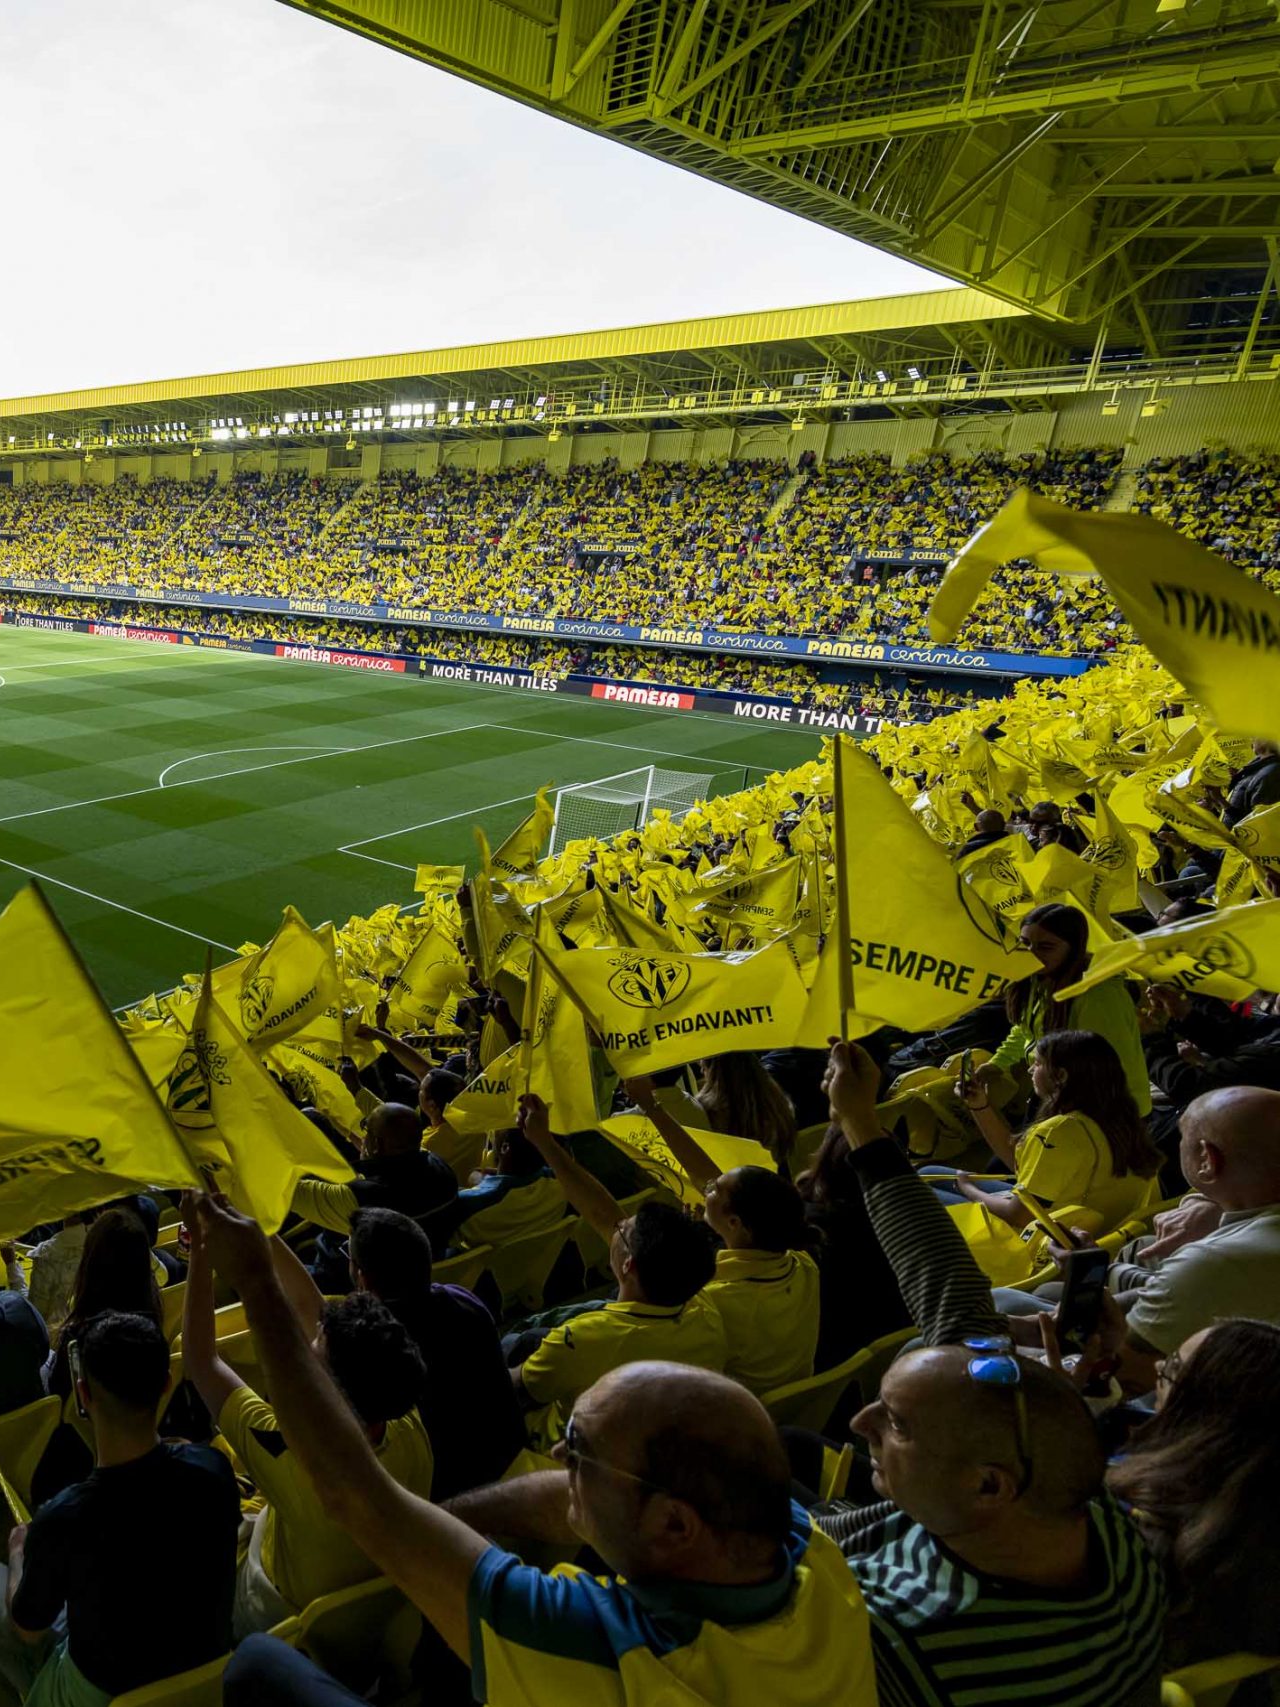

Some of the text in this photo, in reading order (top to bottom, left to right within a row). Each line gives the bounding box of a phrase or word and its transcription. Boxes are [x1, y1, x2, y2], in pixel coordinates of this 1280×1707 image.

[35, 618, 54, 630] THAN
[55, 620, 74, 632] TILES
[94, 624, 127, 639] PAMESA
[289, 600, 327, 613] PAMESA
[387, 608, 431, 622] PAMESA
[502, 616, 555, 632] PAMESA
[558, 620, 624, 637] cerámica
[640, 627, 704, 645] PAMESA
[707, 633, 788, 651] cerámica
[806, 640, 885, 661] PAMESA
[890, 649, 991, 667] cerámica
[283, 646, 331, 663] PAMESA
[432, 664, 558, 692] MORE THAN TILES
[603, 684, 680, 709] PAMESA
[733, 701, 792, 723] MORE
[798, 707, 856, 731] THAN
[850, 937, 975, 996] SEMPRE
[654, 1005, 774, 1041] ENDAVANT!
